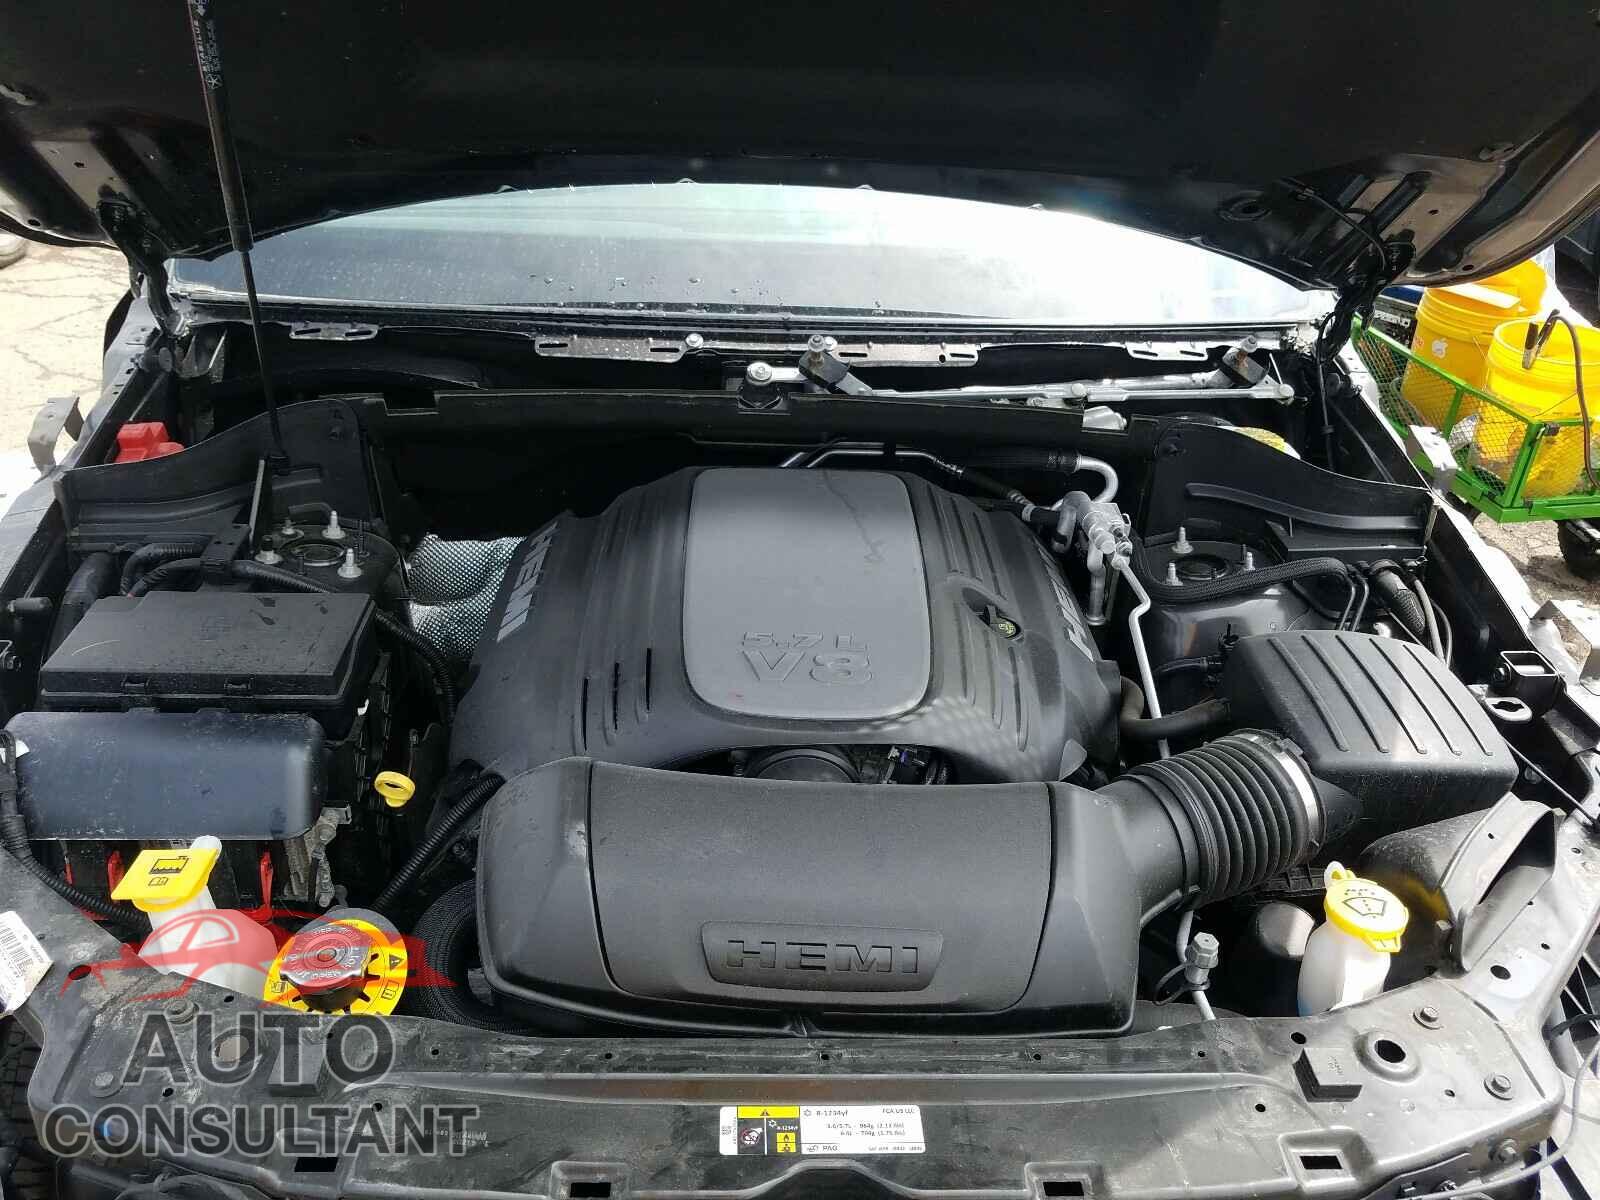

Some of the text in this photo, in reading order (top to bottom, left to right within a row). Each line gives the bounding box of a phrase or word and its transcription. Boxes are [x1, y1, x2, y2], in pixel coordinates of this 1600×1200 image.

[742, 631, 869, 652] 5.7L
[741, 650, 873, 684] V8
[726, 939, 919, 974] HEMI
